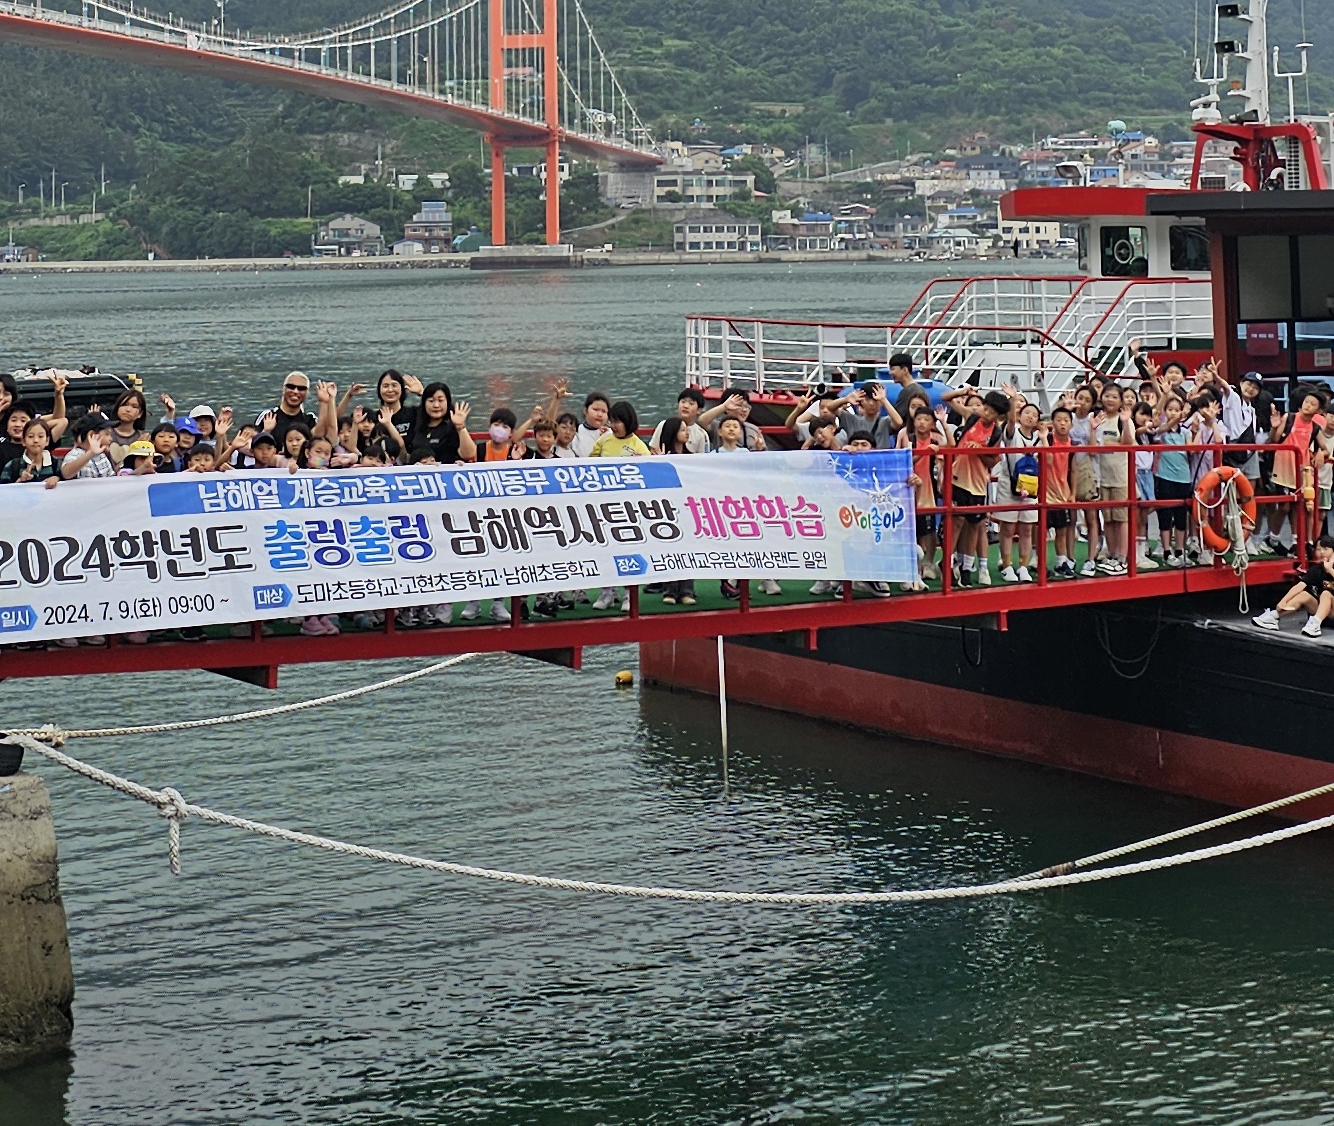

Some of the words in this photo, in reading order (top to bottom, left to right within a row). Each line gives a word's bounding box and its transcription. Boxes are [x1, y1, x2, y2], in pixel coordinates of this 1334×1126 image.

[198, 478, 282, 512] 남해얼
[452, 467, 550, 498] 어깨동무
[553, 462, 648, 493] 인성교육
[263, 513, 436, 570] 출렁출렁
[441, 498, 682, 556] 남해역사탐방
[684, 494, 827, 539] 체험학습
[839, 504, 904, 543] 아이좋아
[617, 557, 641, 573] 장소
[650, 550, 801, 572] 남해대교유람선해상랜드
[802, 551, 828, 570] 일원
[43, 604, 95, 626] 2024.
[118, 596, 162, 620] 9.(화)
[168, 594, 215, 615] 09:00
[256, 587, 284, 606] 대상
[0, 609, 30, 628] 일시
